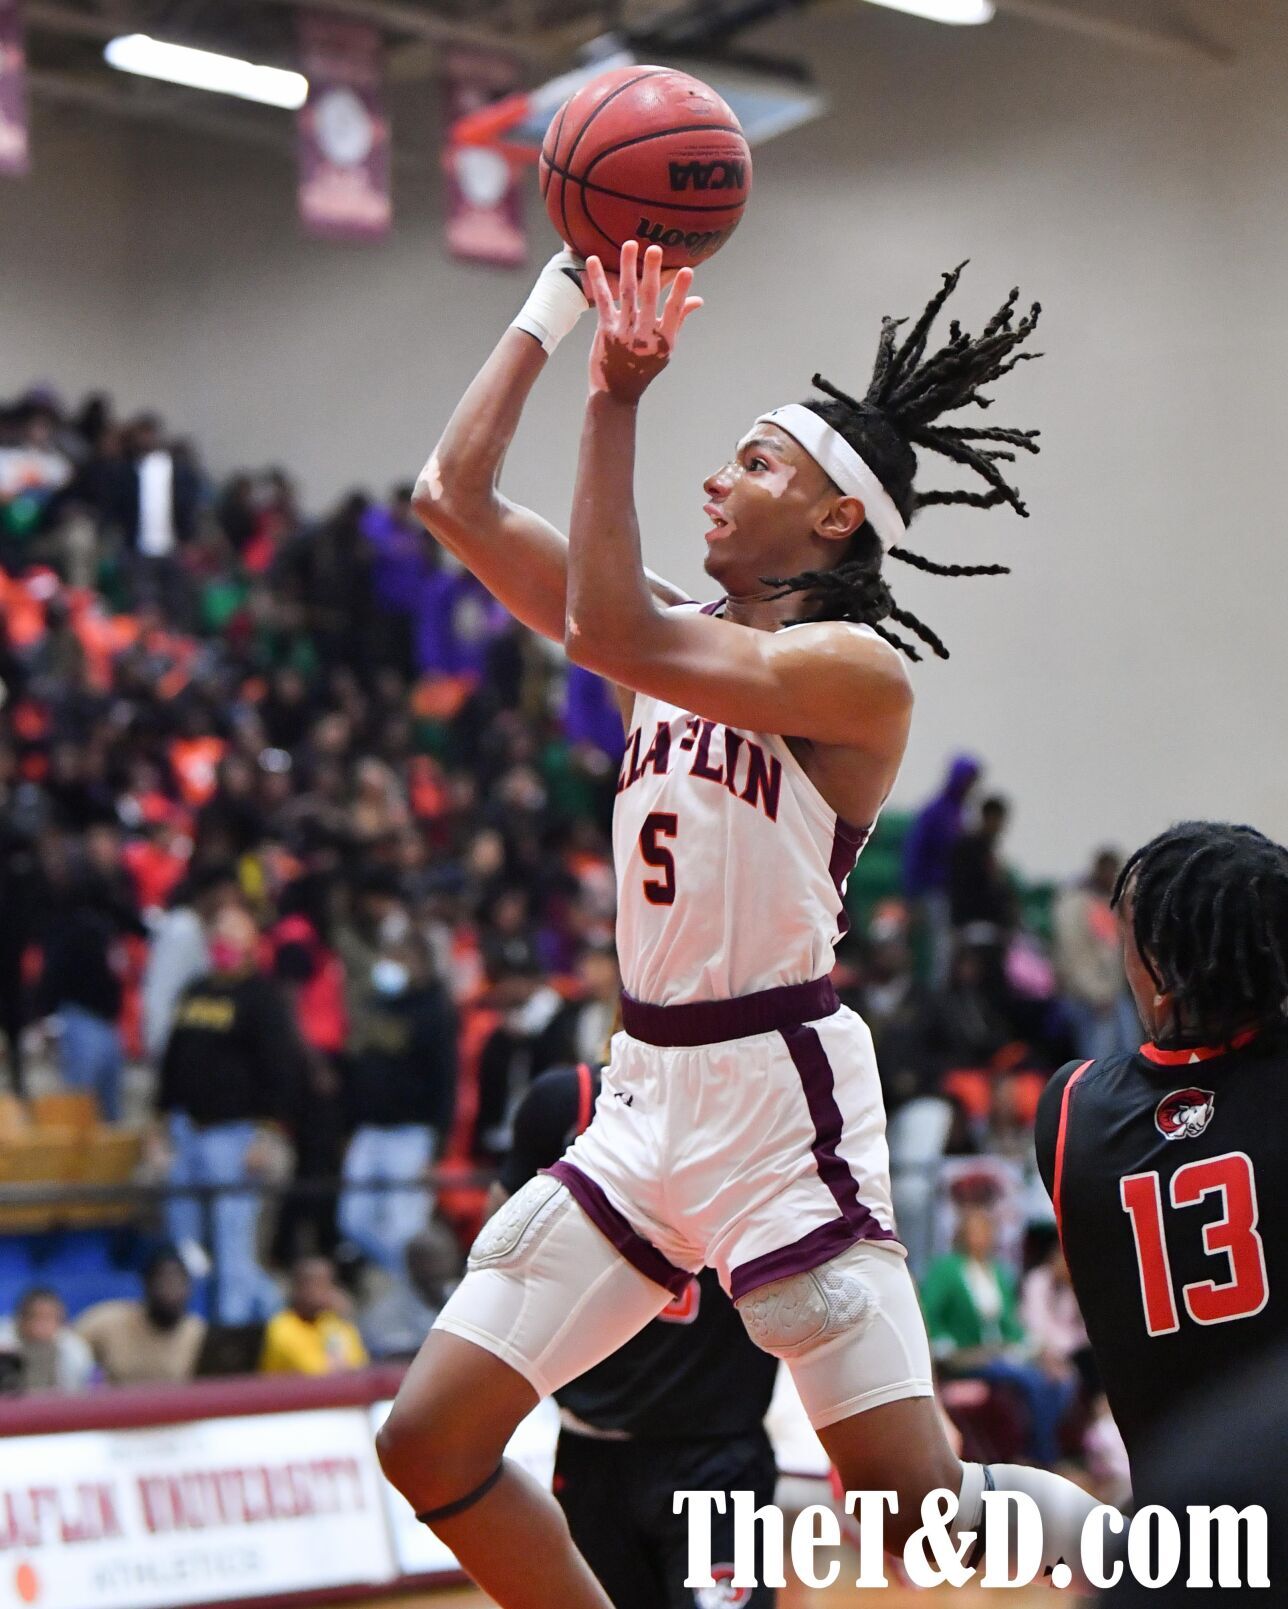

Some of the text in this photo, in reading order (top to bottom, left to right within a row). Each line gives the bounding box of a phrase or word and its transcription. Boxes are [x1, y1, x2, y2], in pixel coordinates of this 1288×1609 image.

[668, 159, 745, 191] NCAA
[638, 811, 678, 907] 5
[1120, 1151, 1269, 1337] 13
